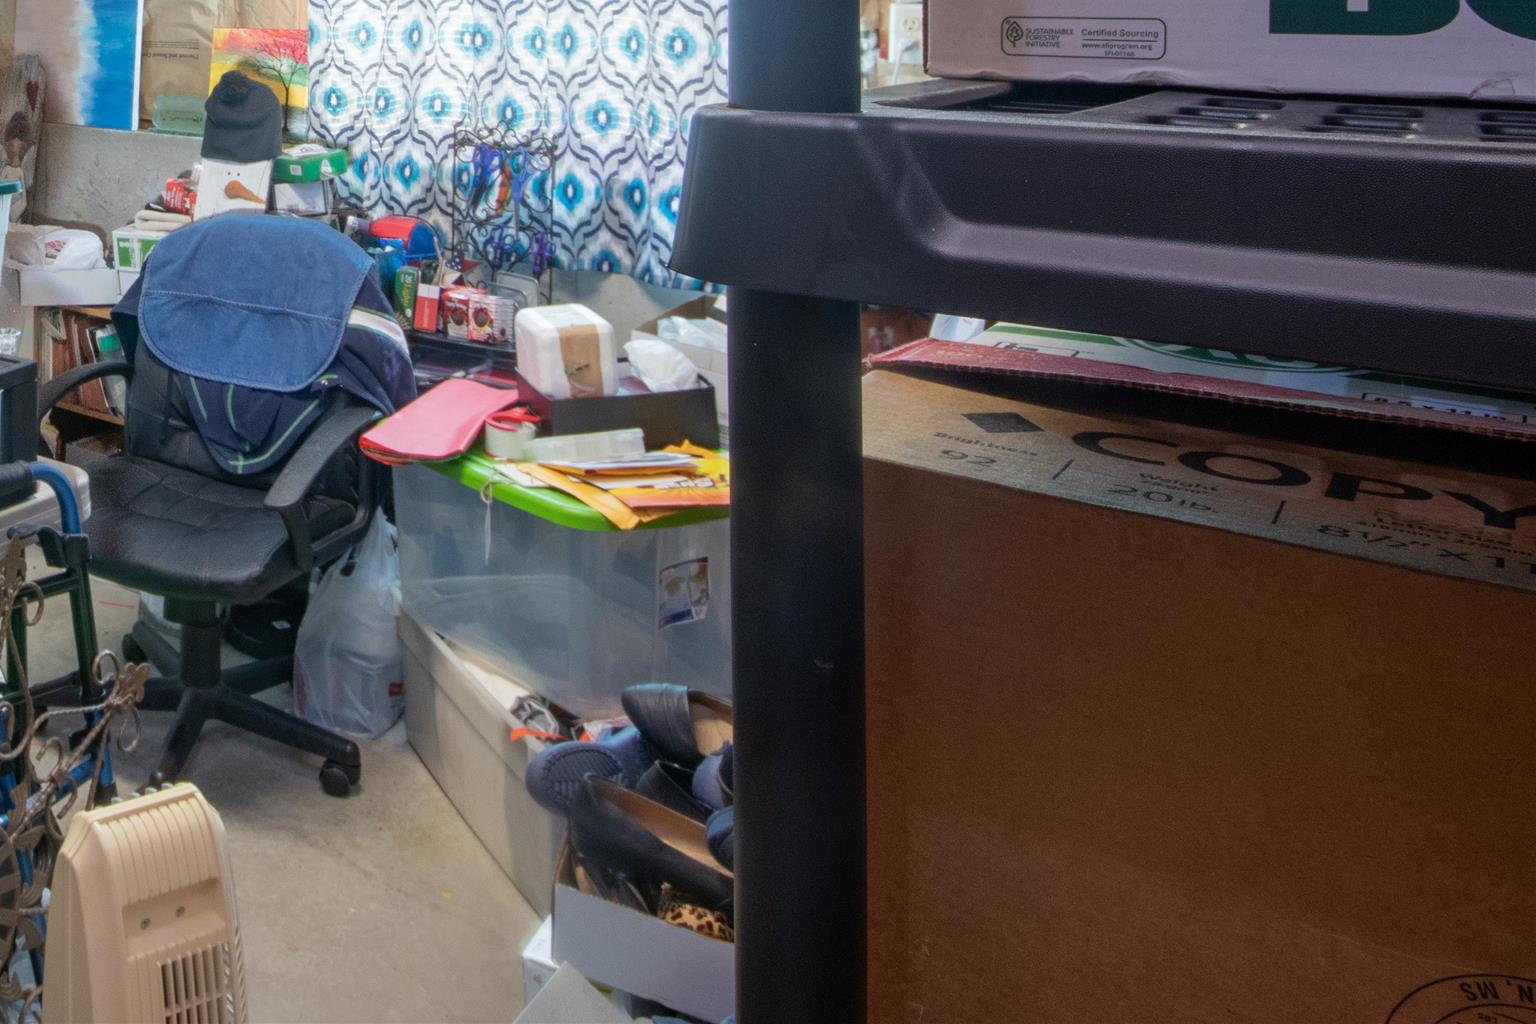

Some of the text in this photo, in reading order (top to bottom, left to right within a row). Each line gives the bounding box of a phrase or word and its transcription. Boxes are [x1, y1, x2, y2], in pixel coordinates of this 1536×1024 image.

[1024, 27, 1075, 36] SUSTAINABLE
[1080, 27, 1159, 40] Certified Sourcing
[933, 431, 1039, 457] Brightness
[940, 448, 998, 468] 92
[1071, 431, 1536, 530] COPY
[1138, 472, 1219, 493] Weight
